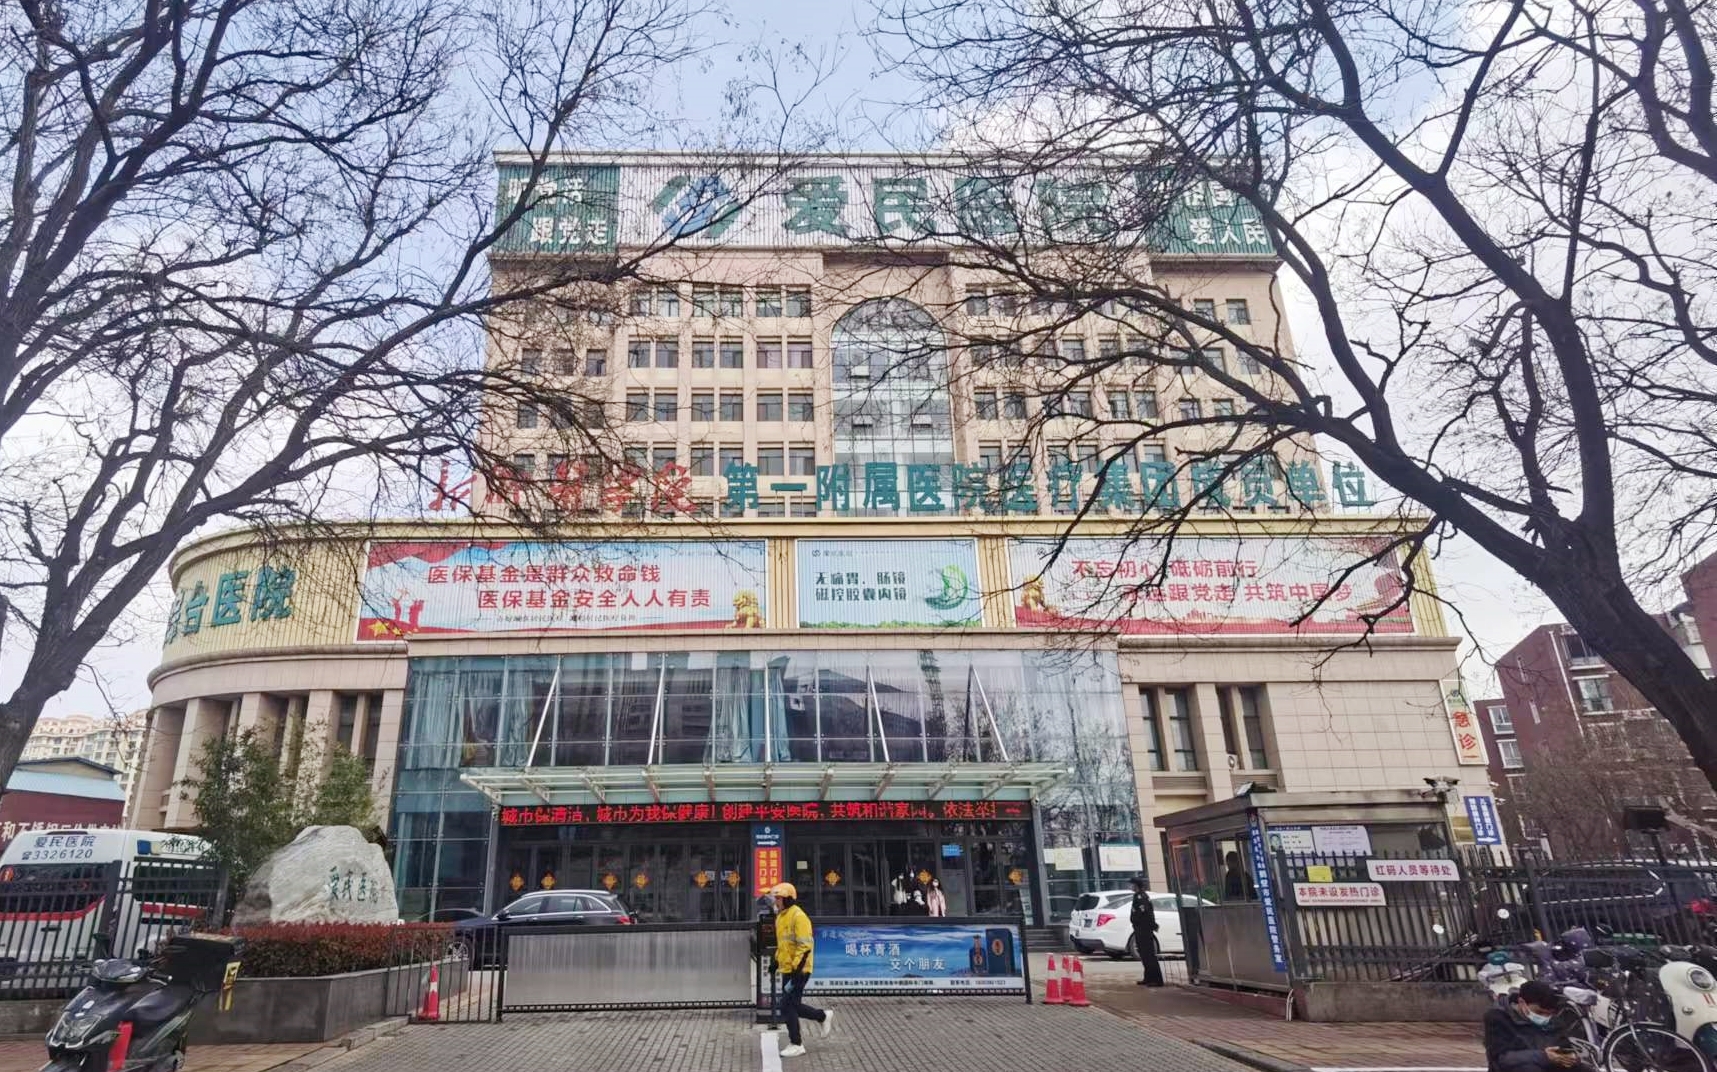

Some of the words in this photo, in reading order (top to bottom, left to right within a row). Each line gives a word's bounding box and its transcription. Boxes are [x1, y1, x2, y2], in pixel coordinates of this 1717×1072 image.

[530, 217, 607, 244] 跟党走
[1189, 217, 1267, 245] 爱人民
[428, 564, 661, 585] 医保基金是群众救命钱
[477, 589, 711, 609] 医保基金安全人人有责
[1244, 581, 1353, 602] 共筑中国梦
[1453, 711, 1476, 749] 急诊
[34, 836, 97, 848] 爱民医院
[33, 848, 93, 860] 3326120
[1375, 863, 1452, 876] 红码人员等待处
[1298, 885, 1381, 898] 本院未设发热门诊
[889, 957, 946, 971] 交个朋友
